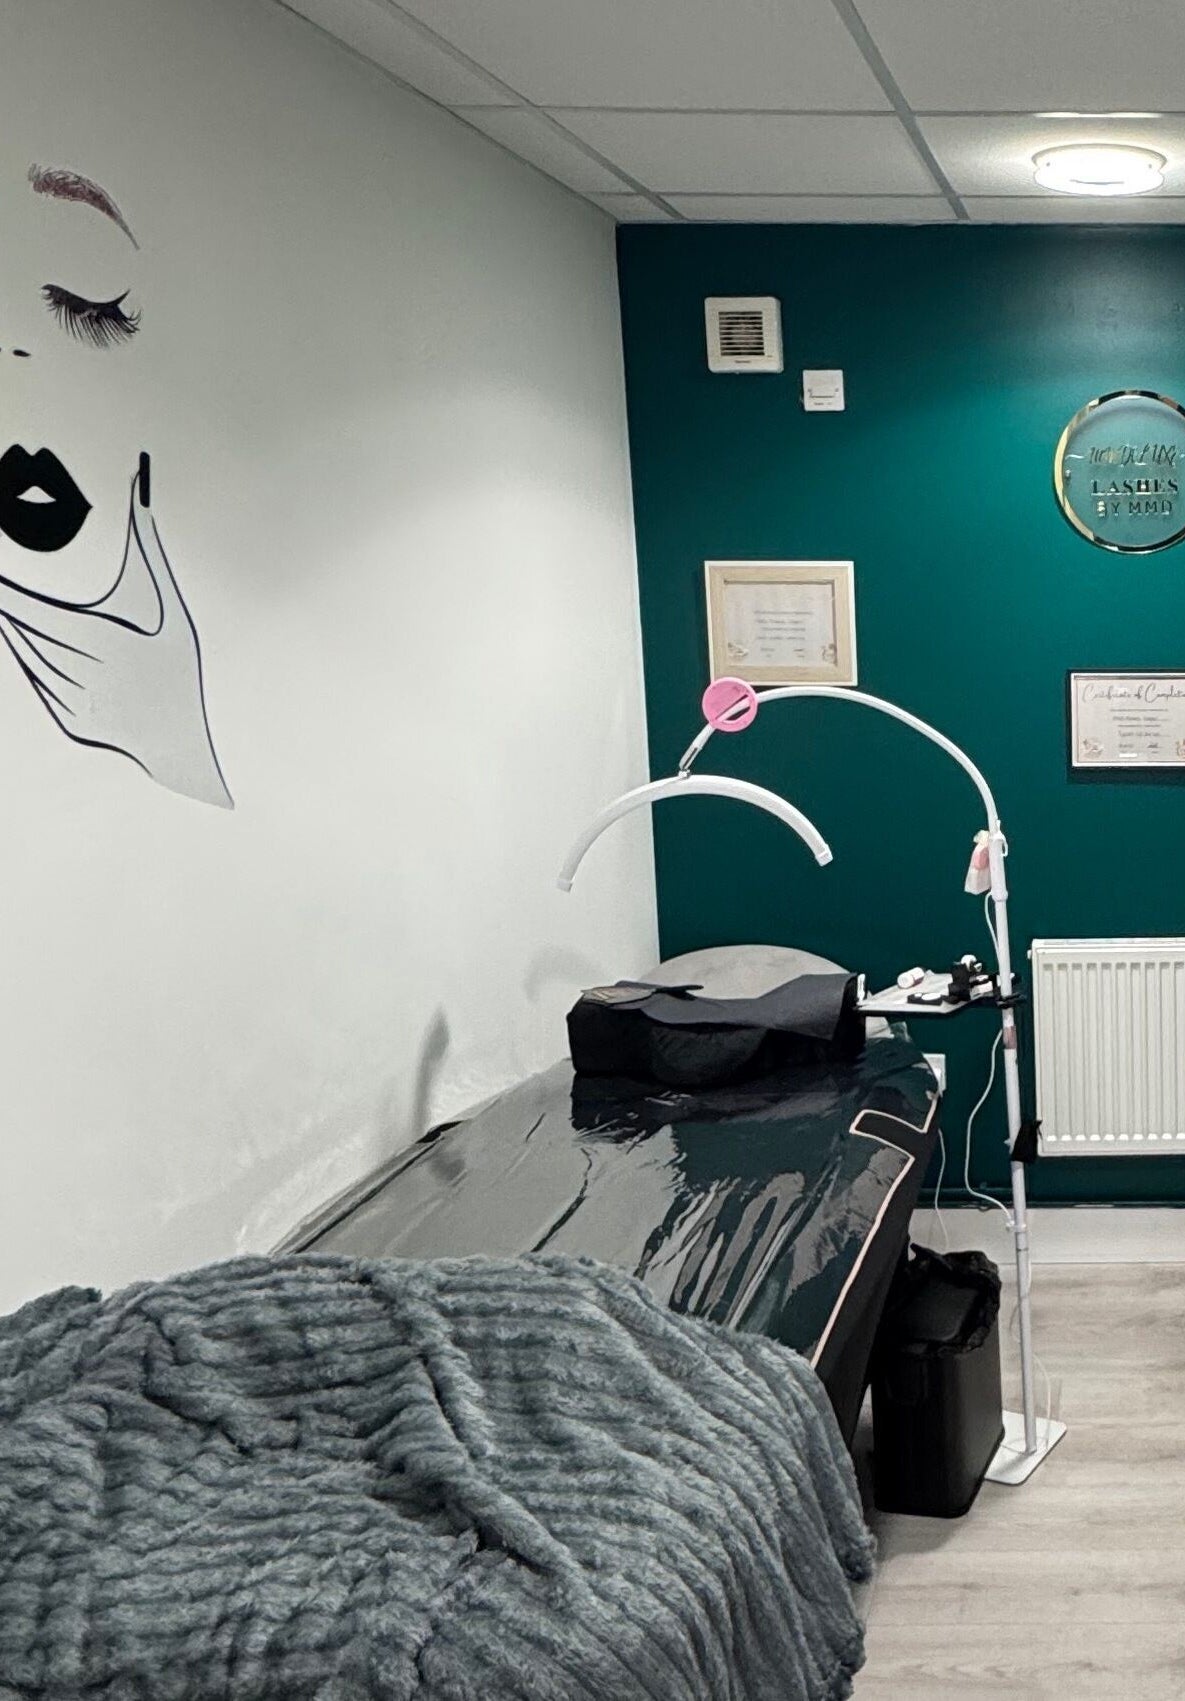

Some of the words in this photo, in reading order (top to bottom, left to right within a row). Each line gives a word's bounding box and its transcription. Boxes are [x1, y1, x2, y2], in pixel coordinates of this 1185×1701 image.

[1091, 479, 1178, 495] LASHES
[1097, 501, 1120, 516] BY
[1128, 501, 1173, 515] MMD
[1082, 683, 1131, 703] Certificate
[1132, 685, 1143, 700] of
